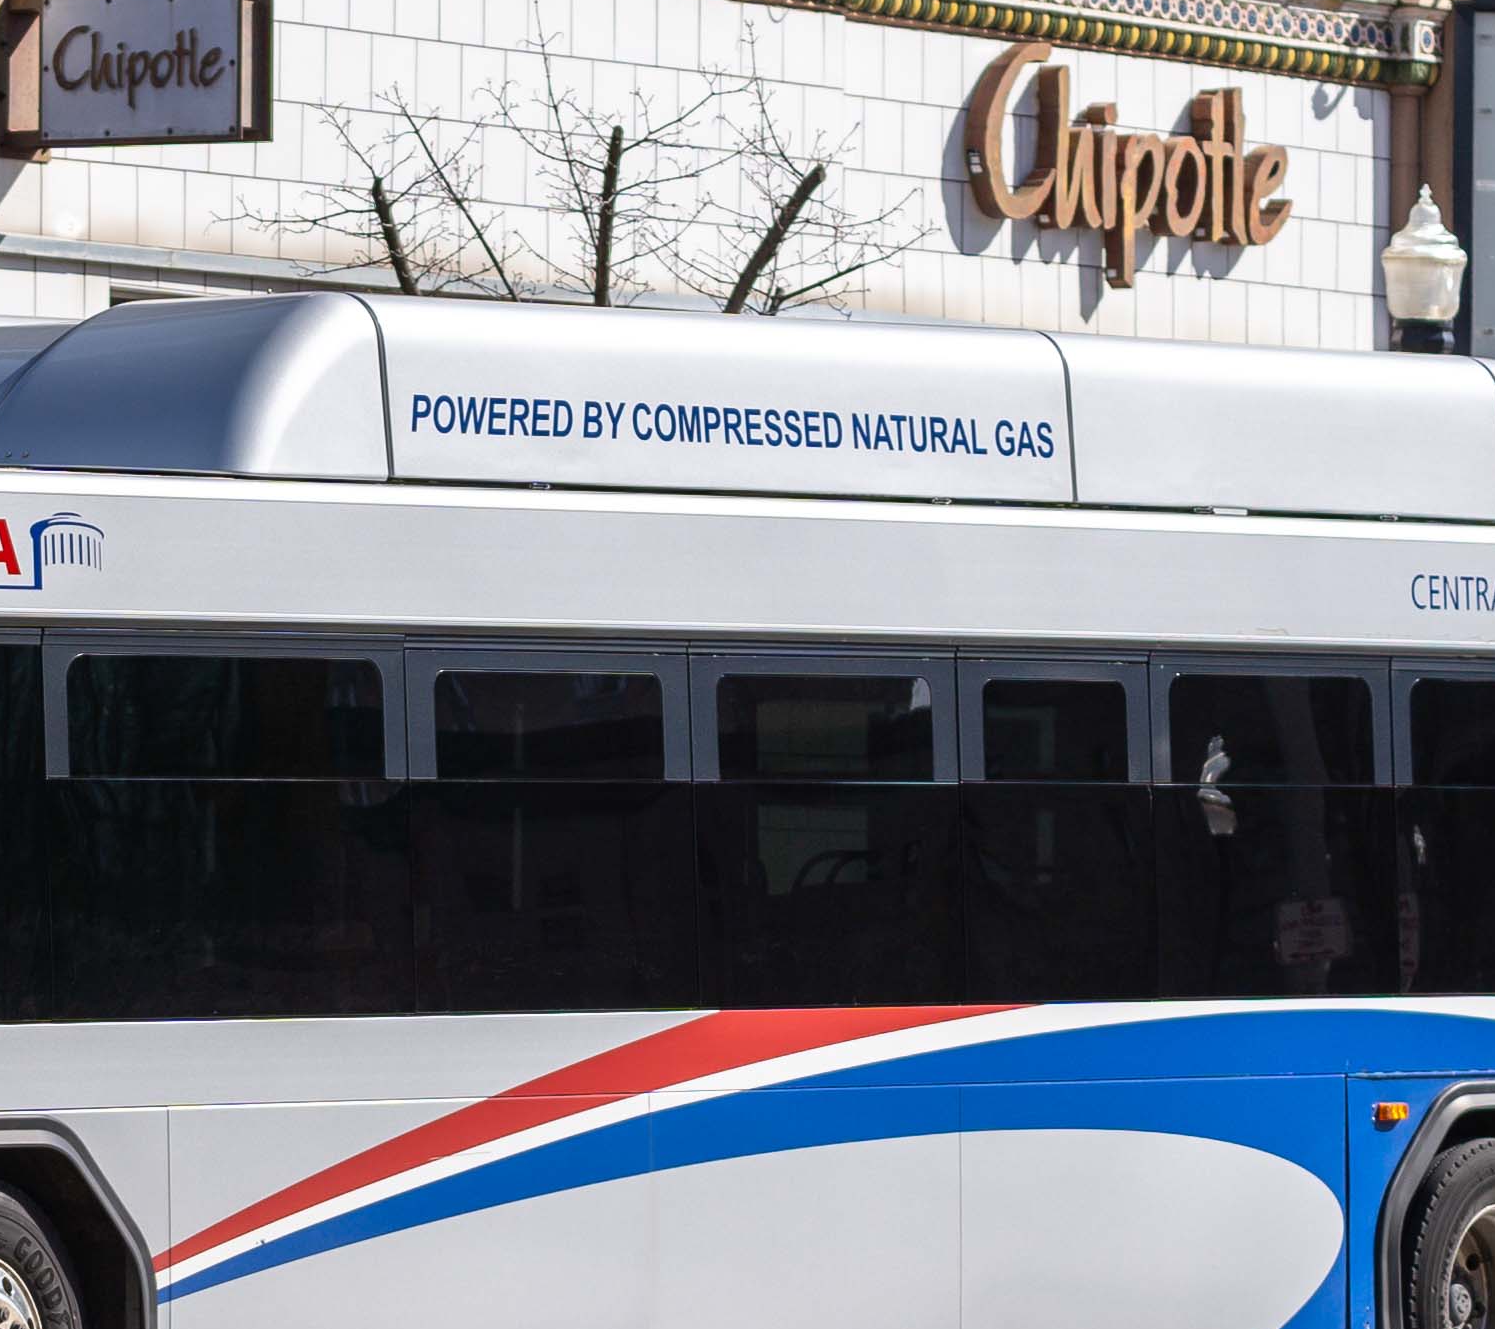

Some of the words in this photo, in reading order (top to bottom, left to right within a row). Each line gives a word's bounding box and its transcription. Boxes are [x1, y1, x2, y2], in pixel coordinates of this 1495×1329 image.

[52, 24, 226, 111] Chipotle
[966, 42, 1293, 289] Chipotle
[411, 394, 573, 438] POWERED
[583, 400, 626, 439] BY
[632, 402, 843, 449] COMPRESSED
[852, 413, 988, 455] NATURAL
[994, 419, 1055, 459] GAS
